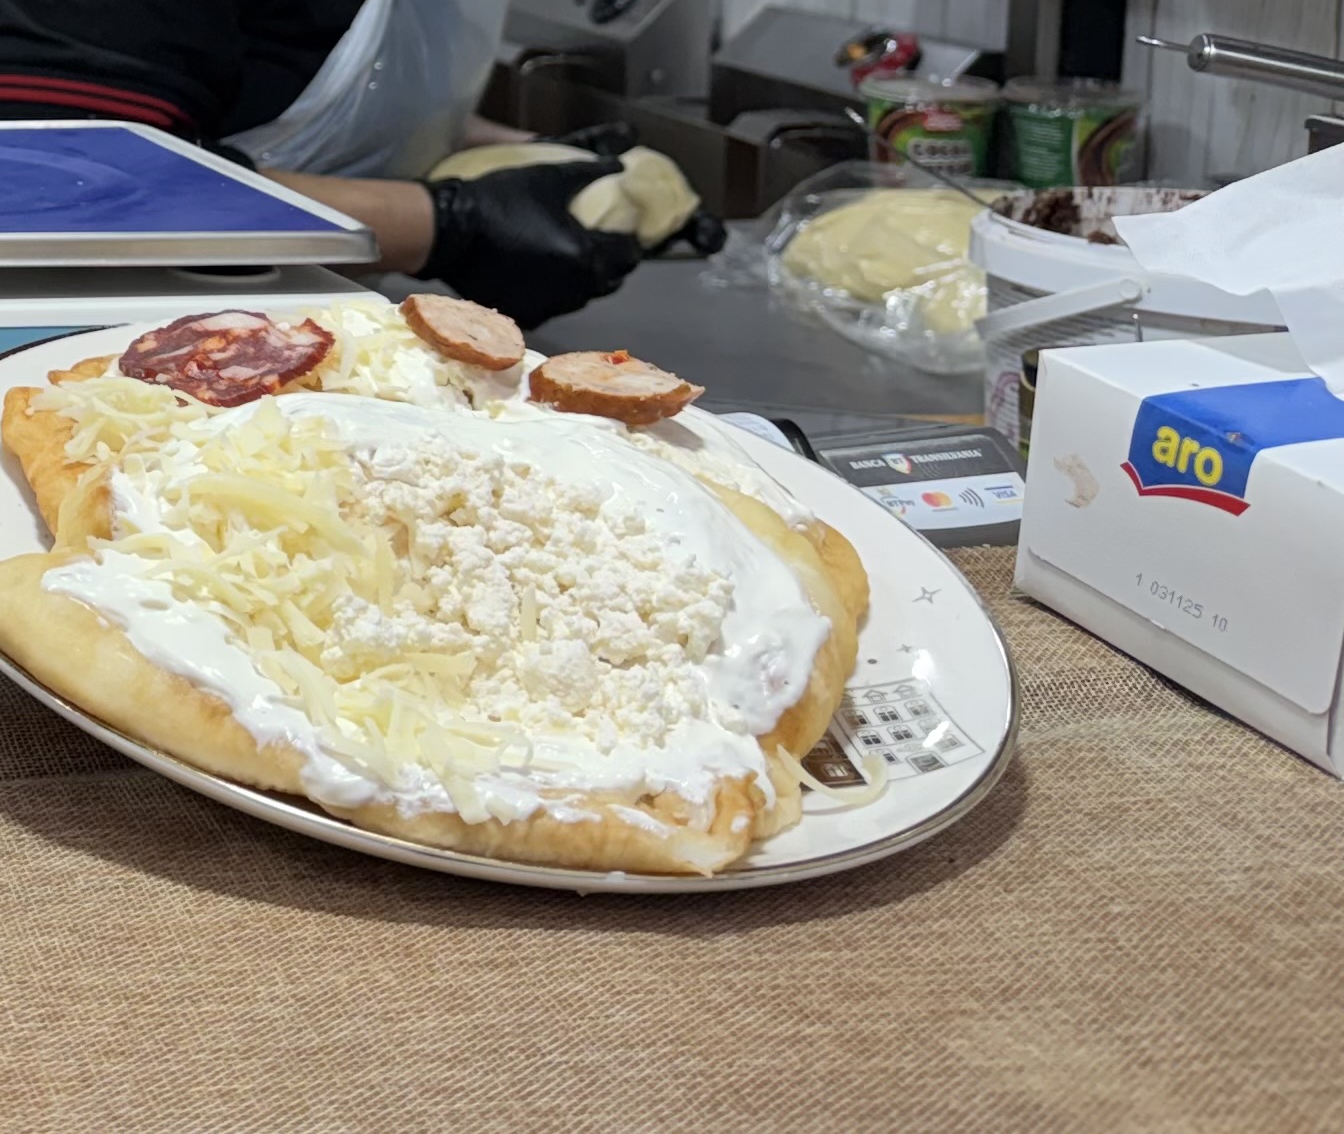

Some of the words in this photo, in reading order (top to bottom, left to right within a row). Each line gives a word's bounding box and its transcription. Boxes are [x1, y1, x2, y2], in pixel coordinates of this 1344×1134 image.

[849, 457, 887, 470] BANCA
[1151, 424, 1224, 486] aro
[992, 490, 1018, 500] VISA
[1134, 571, 1144, 587] 1
[1149, 580, 1204, 620] 031125
[1211, 611, 1230, 633] 10
